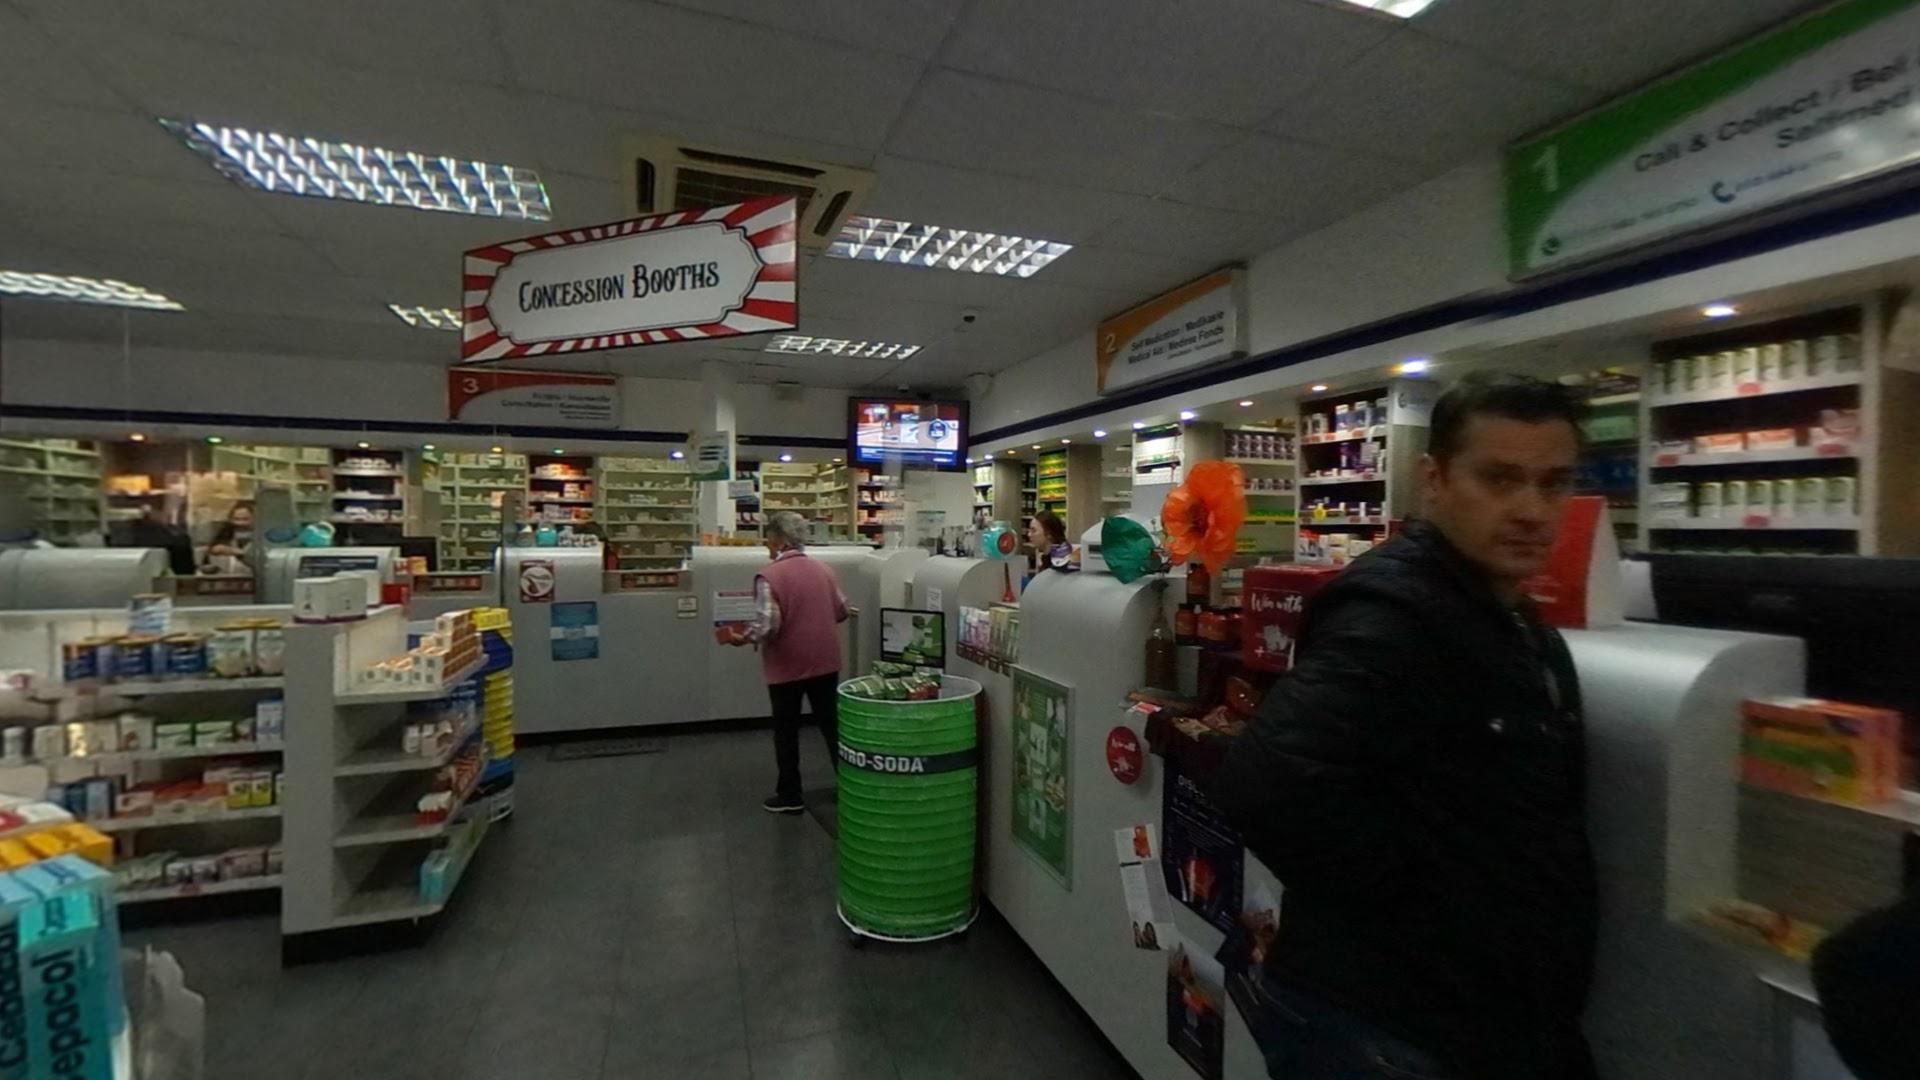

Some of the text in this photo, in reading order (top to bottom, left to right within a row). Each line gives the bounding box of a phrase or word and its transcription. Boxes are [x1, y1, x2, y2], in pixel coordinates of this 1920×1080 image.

[1717, 91, 1820, 141] Collect
[1534, 146, 1559, 192] 1
[518, 260, 721, 314] CONCESSION BOOTHS
[1104, 332, 1116, 354] 2
[462, 376, 479, 394] 3
[31, 948, 91, 1080] epacol
